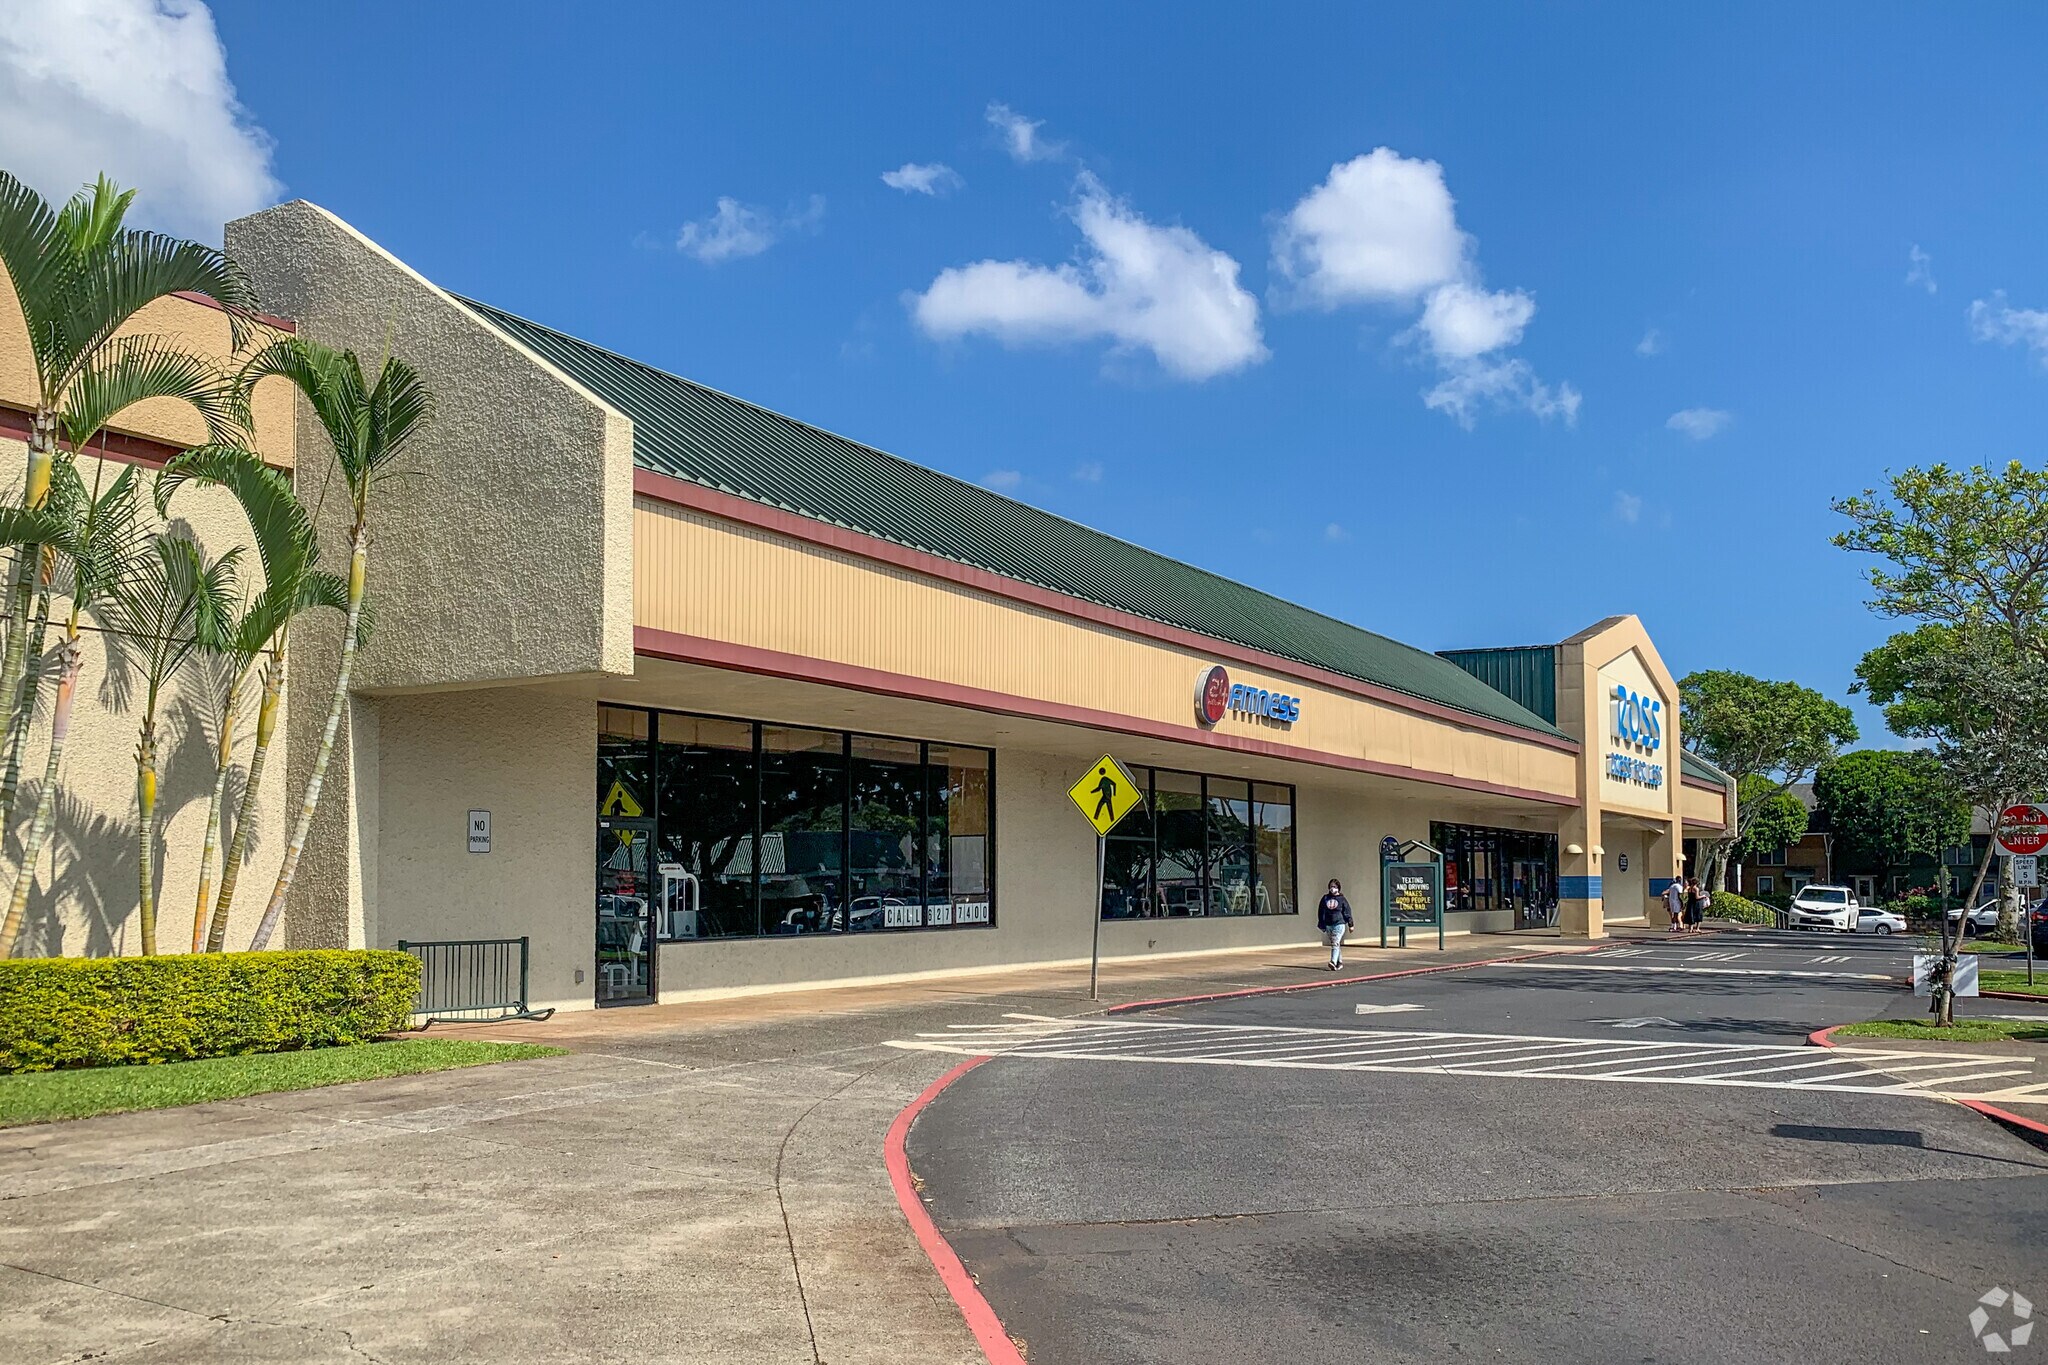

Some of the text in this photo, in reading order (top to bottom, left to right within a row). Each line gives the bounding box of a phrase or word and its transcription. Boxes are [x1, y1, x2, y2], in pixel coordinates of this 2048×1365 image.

[1228, 683, 1301, 723] FITNESS
[1610, 684, 1661, 750] ROSS
[474, 820, 485, 831] NO
[2008, 837, 2040, 845] NTER
[887, 909, 920, 923] CALL
[958, 906, 988, 919] 7400
